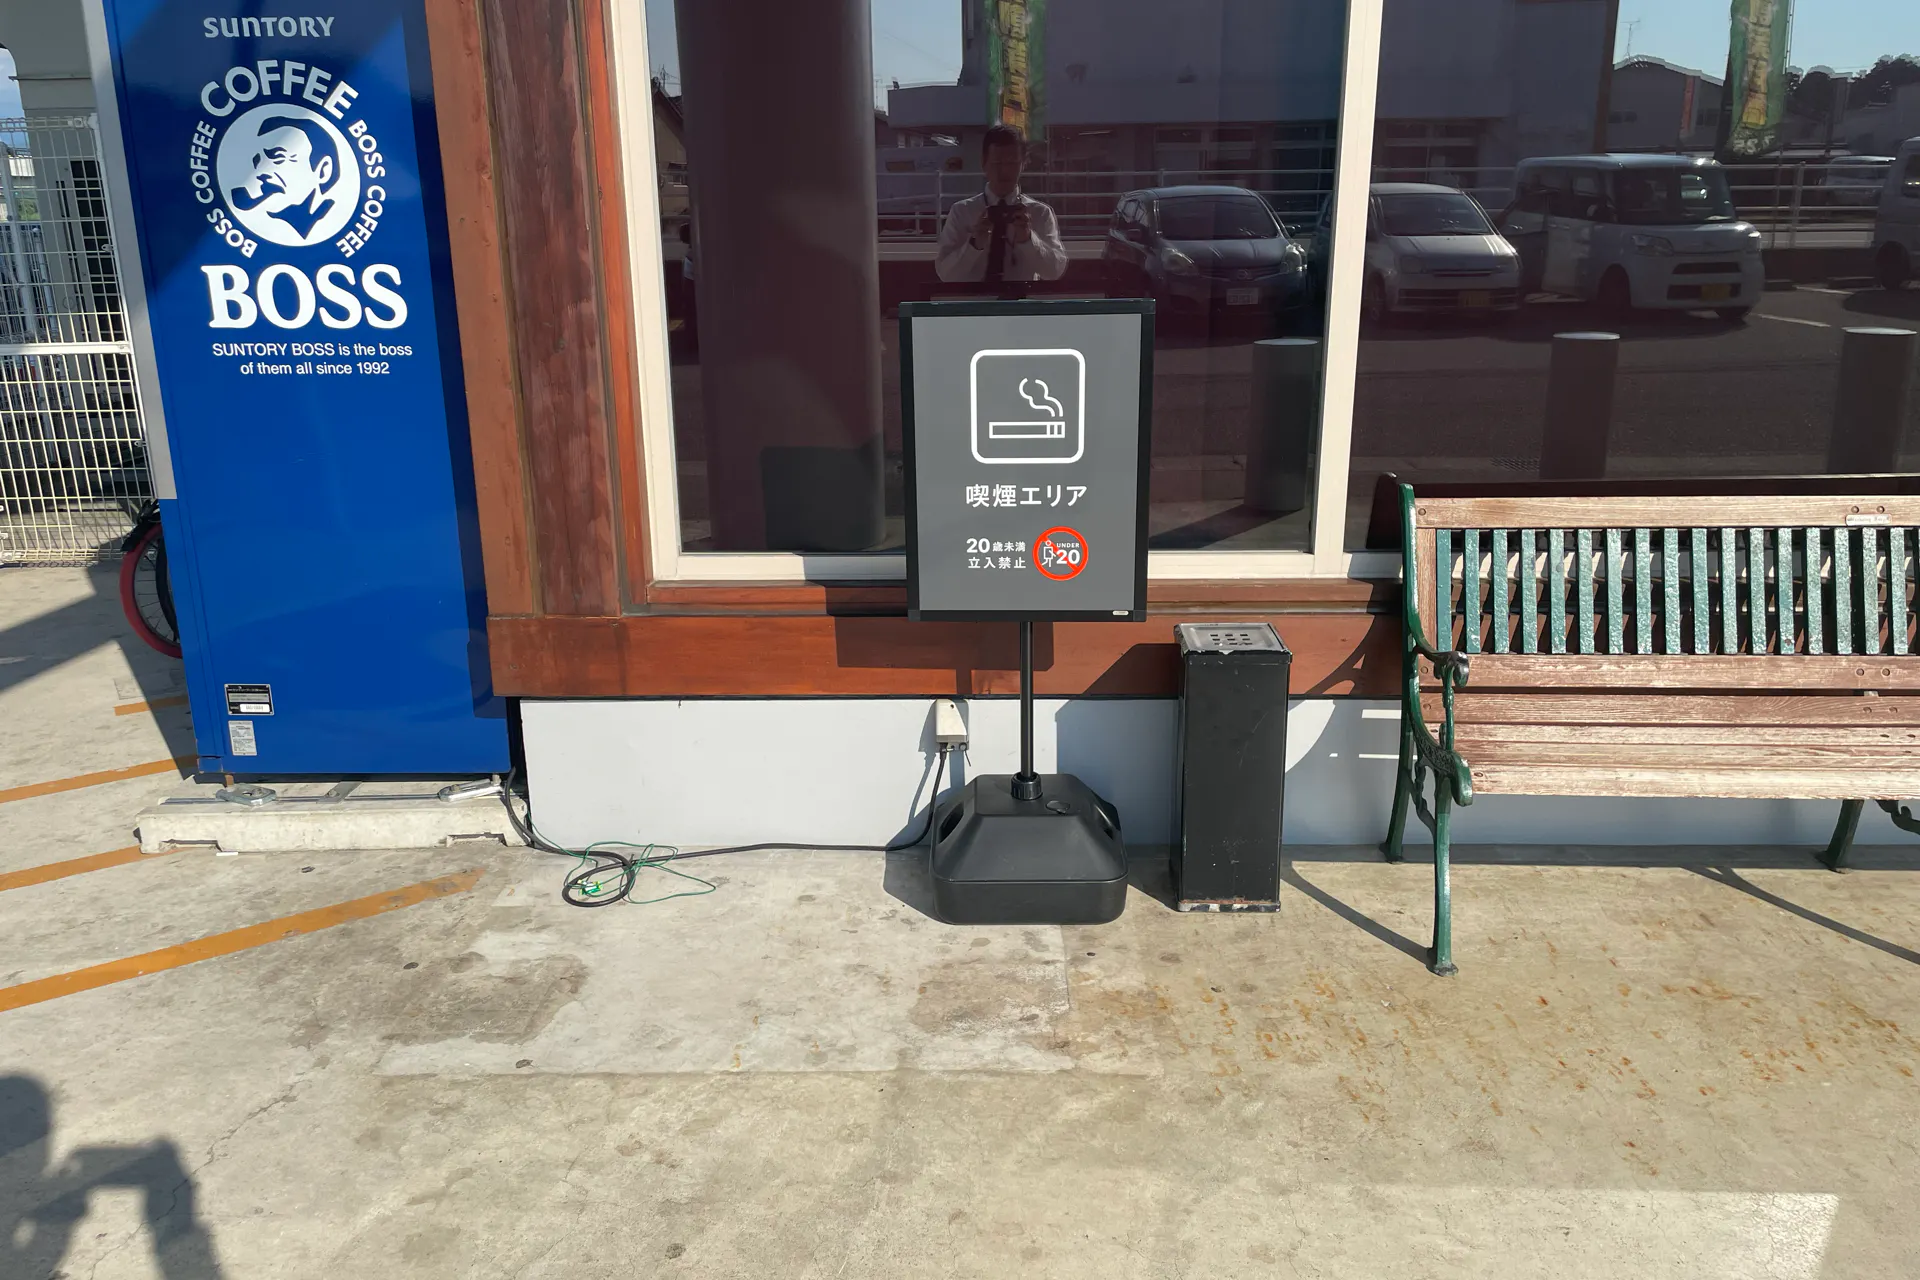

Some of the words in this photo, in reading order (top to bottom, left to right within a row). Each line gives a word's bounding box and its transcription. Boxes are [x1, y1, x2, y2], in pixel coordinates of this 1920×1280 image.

[203, 16, 335, 38] SUNTORY
[200, 59, 359, 120] COFFEE
[190, 120, 217, 204] COFFEE
[348, 119, 386, 178] BOSS
[205, 208, 257, 259] BOSS
[335, 184, 387, 258] COFFEE
[200, 263, 408, 330] BOSS
[212, 343, 287, 356] SUNTORY
[291, 343, 335, 356] BOSS
[338, 343, 351, 356] is
[353, 343, 376, 356] the
[379, 343, 413, 356] boss
[240, 362, 254, 374] of
[257, 362, 292, 374] them
[296, 362, 313, 374] all
[316, 362, 353, 374] since
[356, 362, 390, 374] 1992
[965, 483, 1088, 508] 喫煙エリア
[968, 556, 1027, 569] 立入禁止
[1056, 549, 1080, 565] 20
